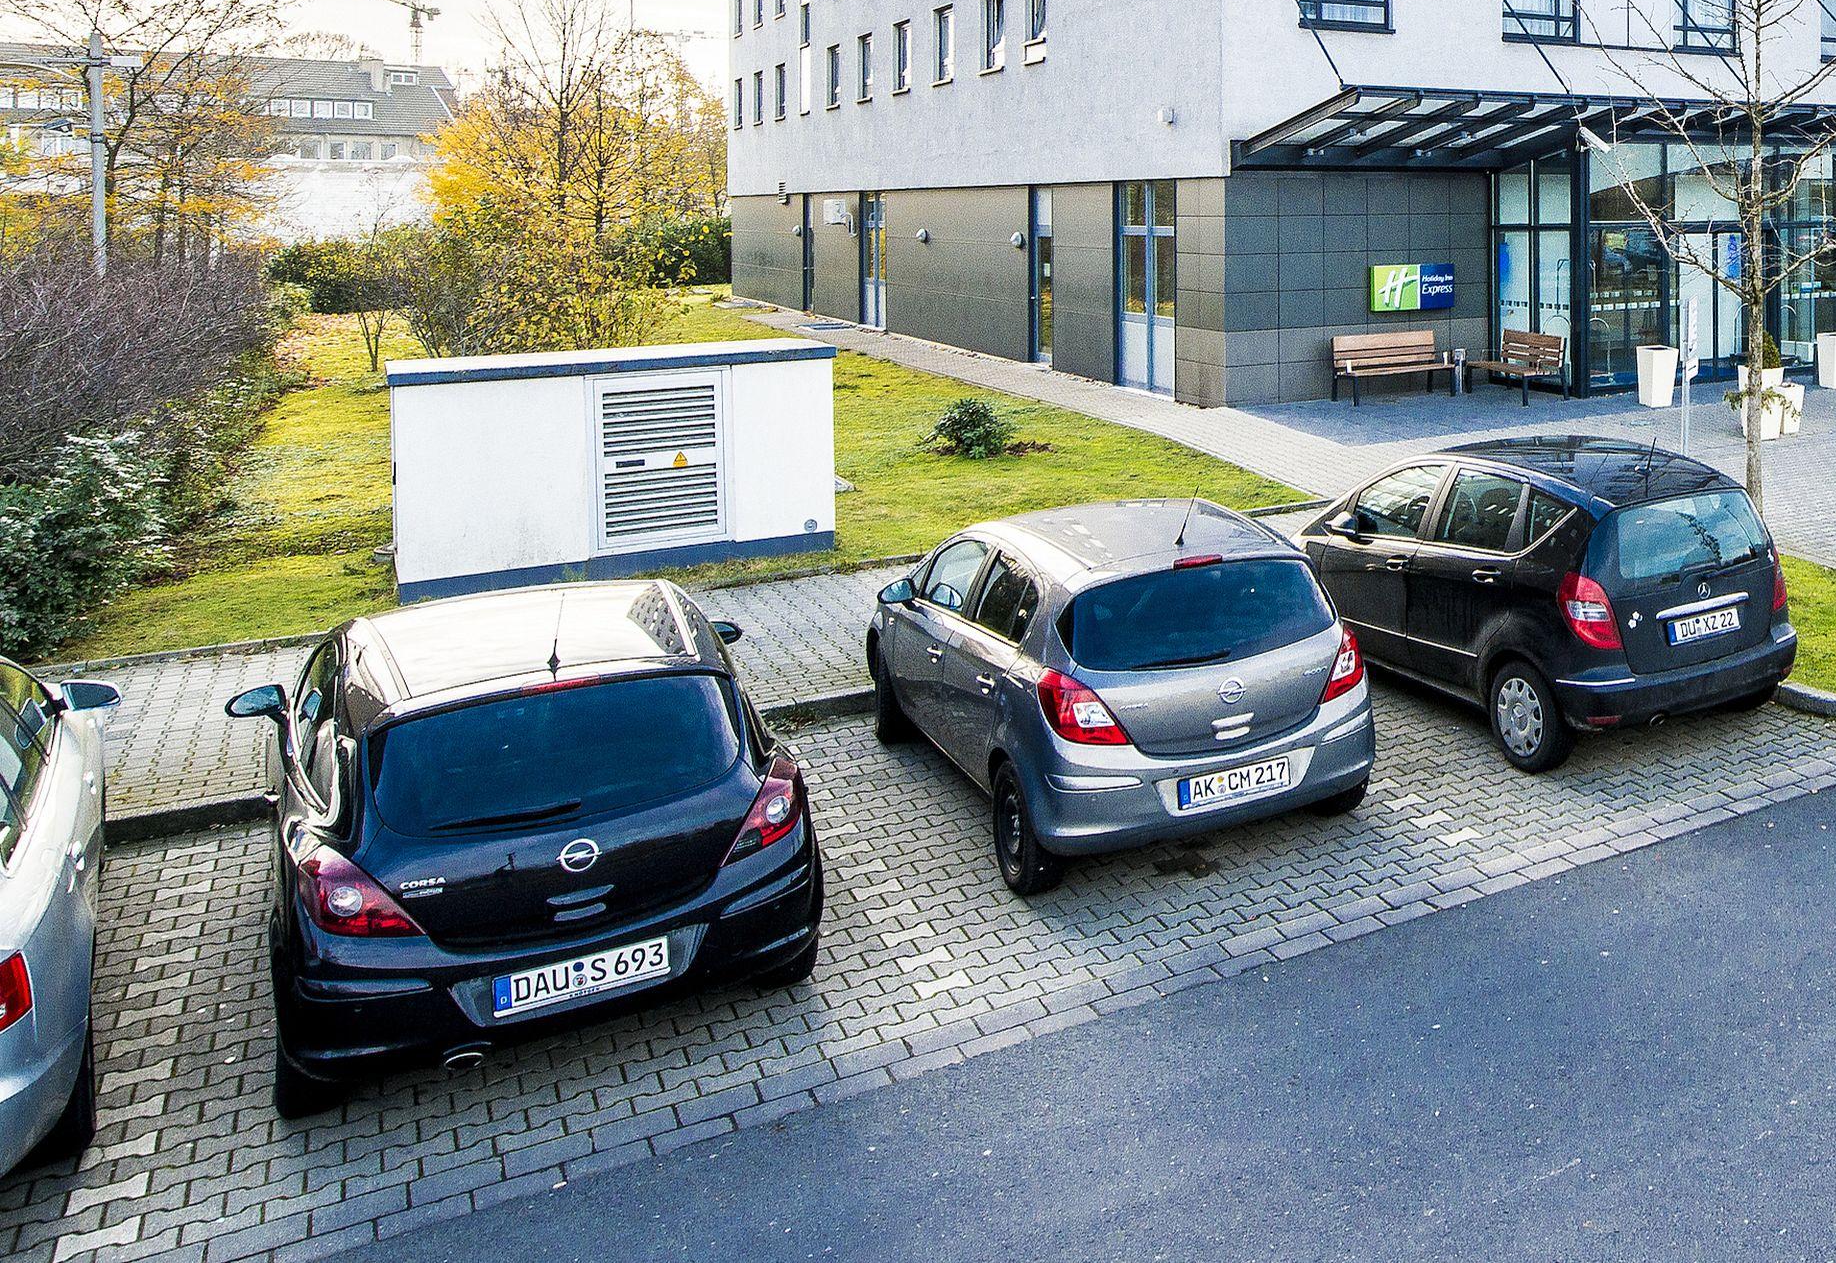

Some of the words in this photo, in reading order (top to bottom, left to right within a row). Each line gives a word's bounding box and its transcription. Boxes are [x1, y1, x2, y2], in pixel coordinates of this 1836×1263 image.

[1421, 274, 1444, 283] Holiday
[1421, 283, 1454, 296] Express
[1680, 620, 1697, 637] DU
[1703, 615, 1719, 632] XZ
[1720, 611, 1735, 628] 22
[1193, 777, 1215, 800] AK
[1228, 769, 1251, 791] CM
[1255, 761, 1286, 785] 217
[513, 966, 570, 1003] DAU
[590, 957, 607, 982] S
[614, 942, 664, 976] 693
